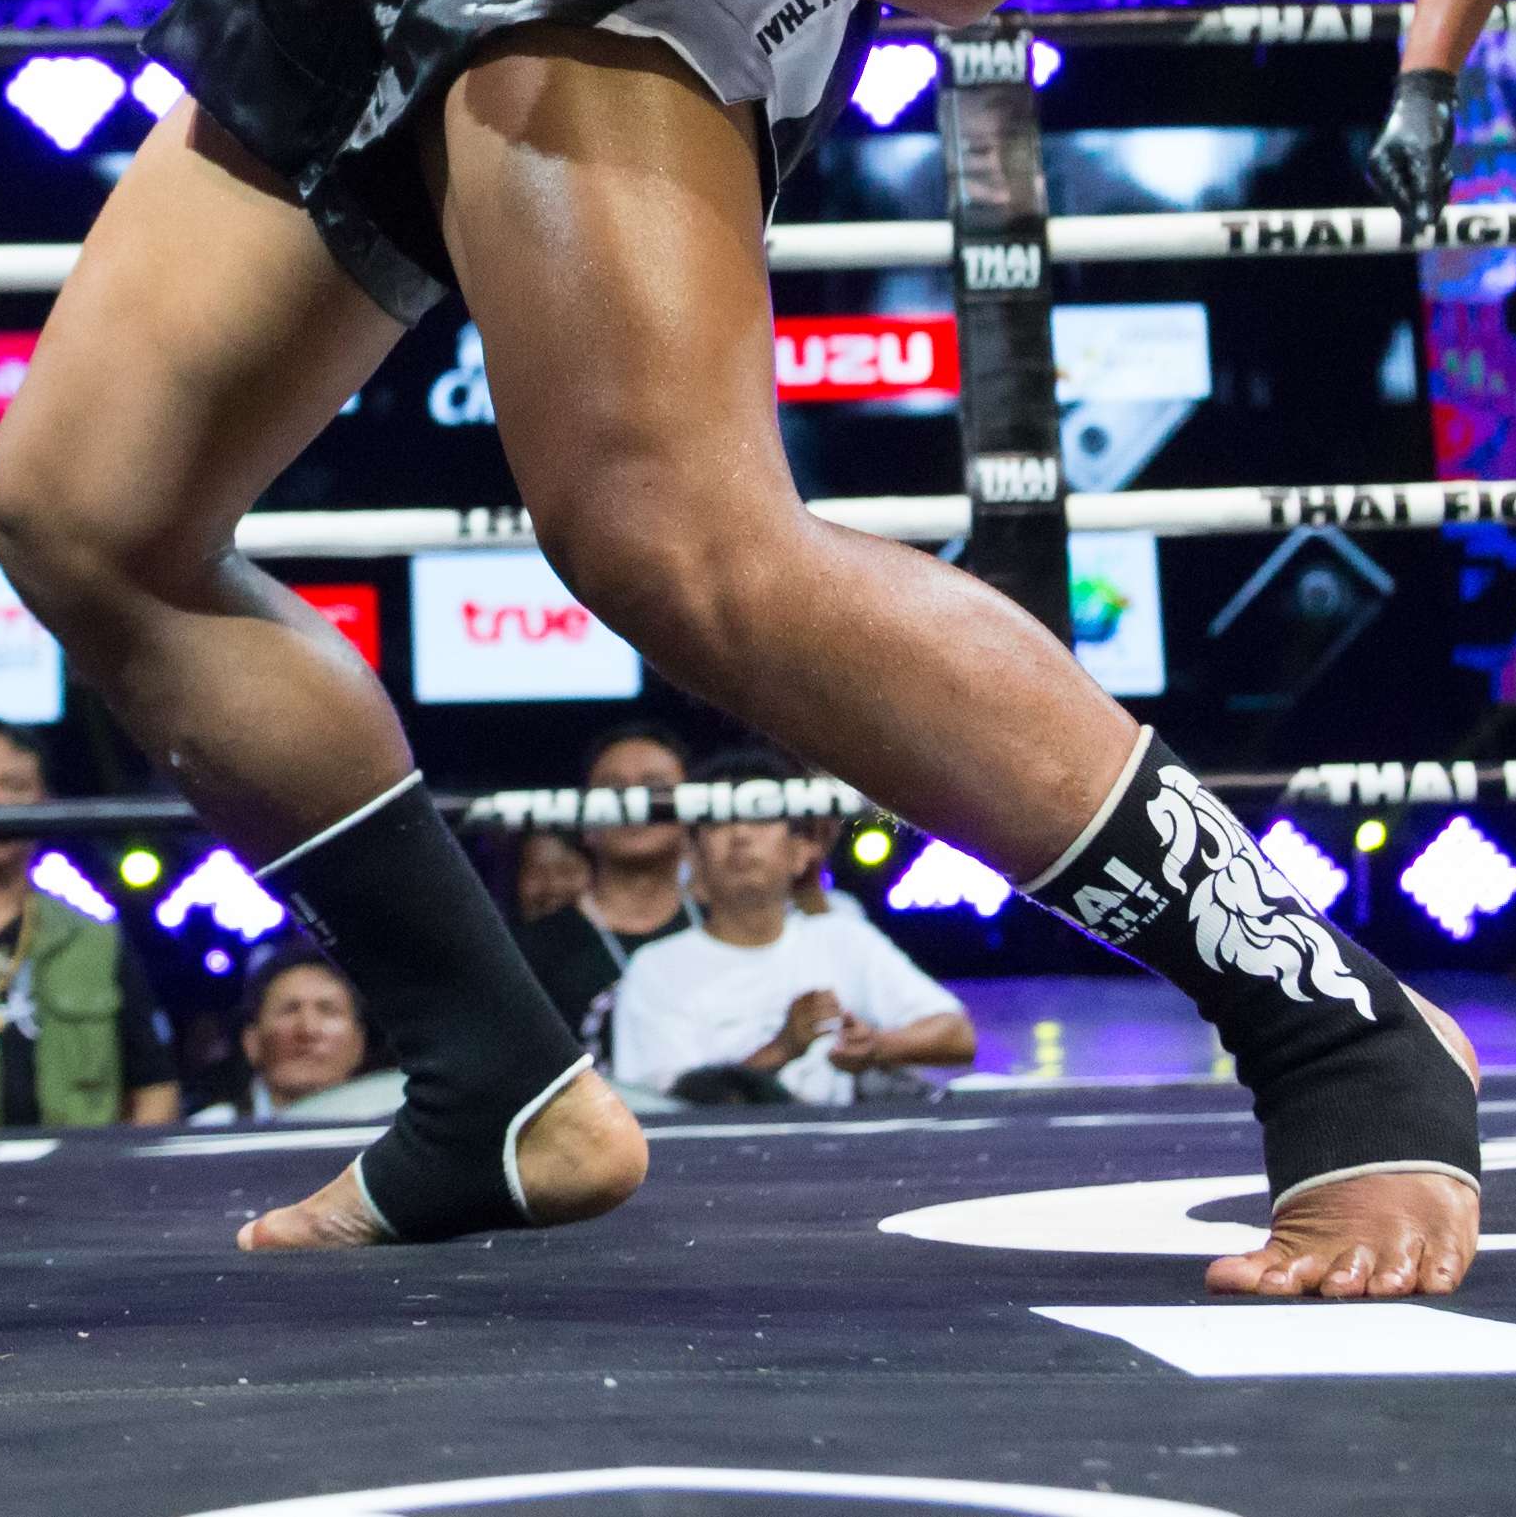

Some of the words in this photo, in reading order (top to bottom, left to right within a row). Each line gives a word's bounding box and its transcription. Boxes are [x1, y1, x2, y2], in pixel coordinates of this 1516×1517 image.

[1222, 4, 1372, 43] THAI
[1221, 216, 1367, 254] THAI
[775, 332, 934, 385] UZU
[1261, 486, 1410, 528] THAI
[461, 599, 589, 645] true
[493, 785, 649, 829] THAI
[674, 777, 863, 823] FIGHT
[1319, 760, 1478, 805] THAI
[1072, 856, 1143, 926] AI
